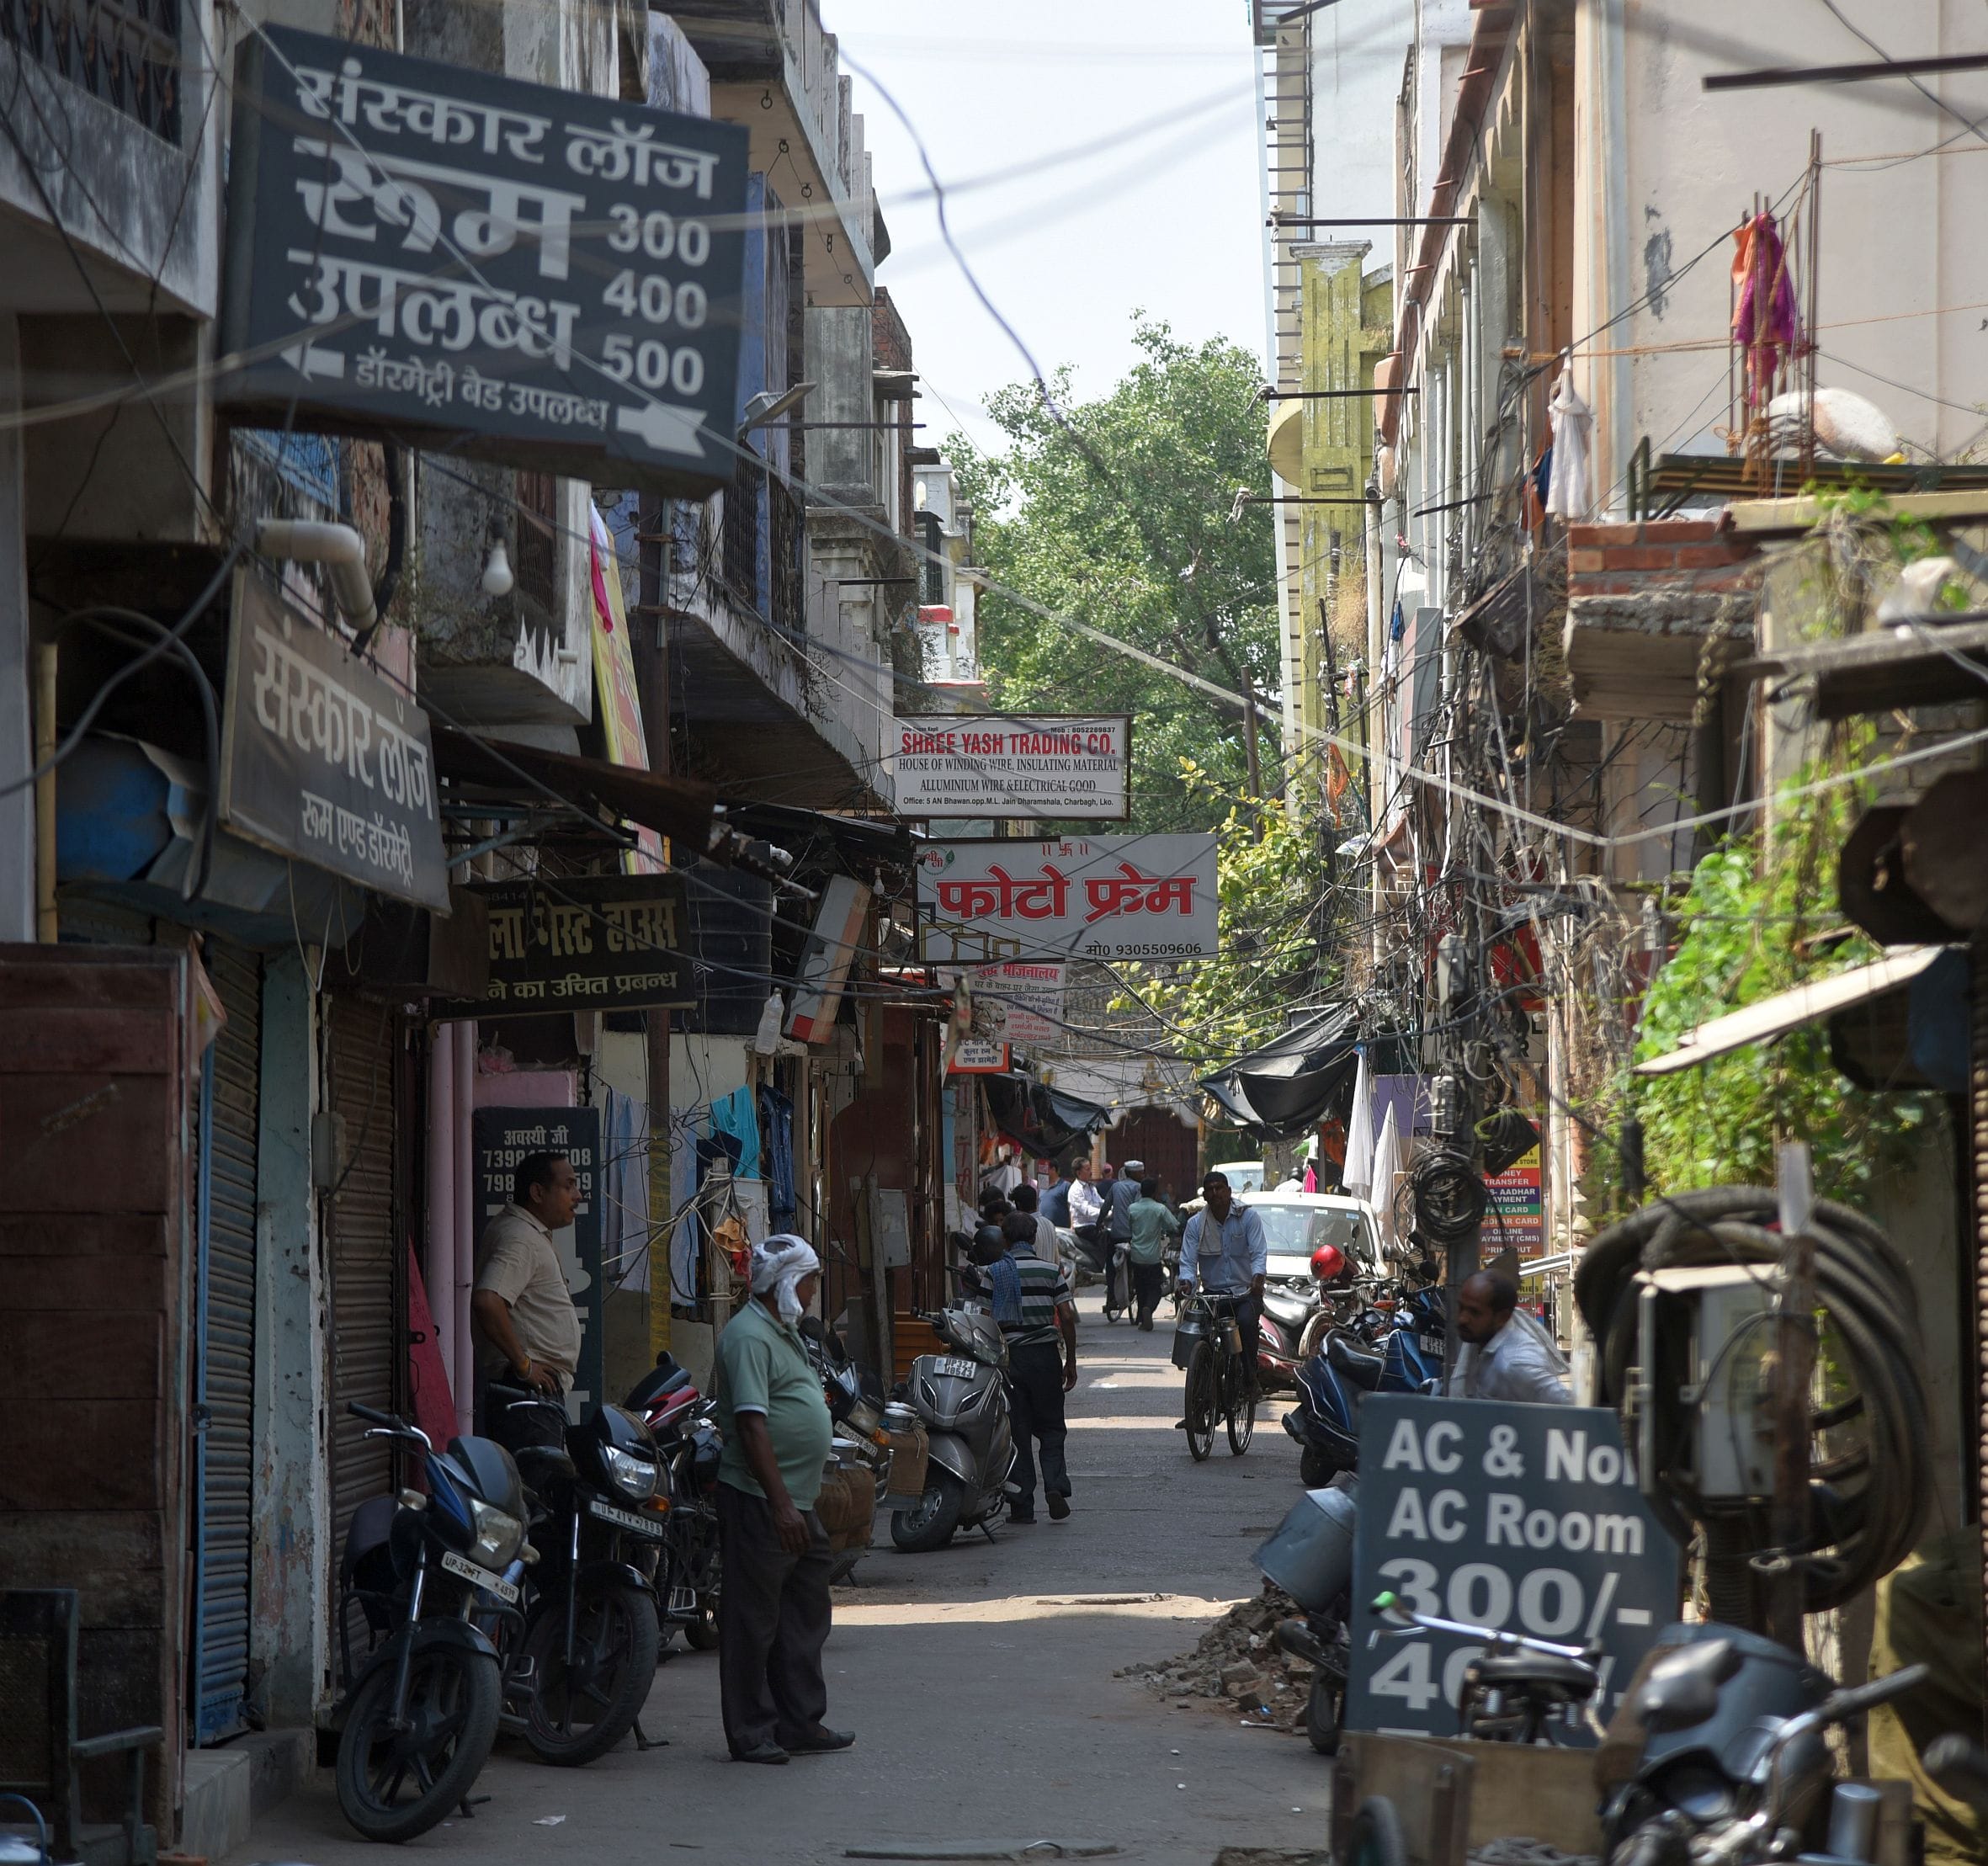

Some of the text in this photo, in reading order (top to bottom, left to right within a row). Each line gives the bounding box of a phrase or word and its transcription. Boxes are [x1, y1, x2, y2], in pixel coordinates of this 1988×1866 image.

[295, 57, 719, 200] संस्कार लॉज
[607, 205, 710, 266] 300
[287, 248, 581, 371] उपलब्ध
[602, 269, 708, 329] 400
[603, 335, 705, 396] 500
[254, 619, 377, 789] संस्कार
[376, 699, 433, 821] लॉज
[901, 732, 1116, 755] SHREE YASH TRADING CO.
[899, 758, 928, 770] HOUSE
[931, 758, 943, 770] OF
[945, 758, 986, 770] WINDING
[1017, 758, 1071, 771] INSULATING
[1073, 758, 1118, 771] MATERIAL
[920, 779, 979, 791] ALLUMINIUM
[981, 779, 1004, 791] WIRE
[1069, 779, 1096, 792] GOOD
[1018, 797, 1062, 806] Dharamshala,
[1064, 798, 1098, 807] Charbagh,
[936, 862, 1199, 923] फोटो फ्रेम
[1116, 944, 1202, 956] 9305509606
[513, 980, 545, 998] का
[551, 973, 609, 997] उचित
[614, 971, 678, 994] प्रबन्ध
[1382, 1418, 1464, 1474] AC
[1482, 1425, 1525, 1478] &
[1386, 1487, 1645, 1555] AC Room
